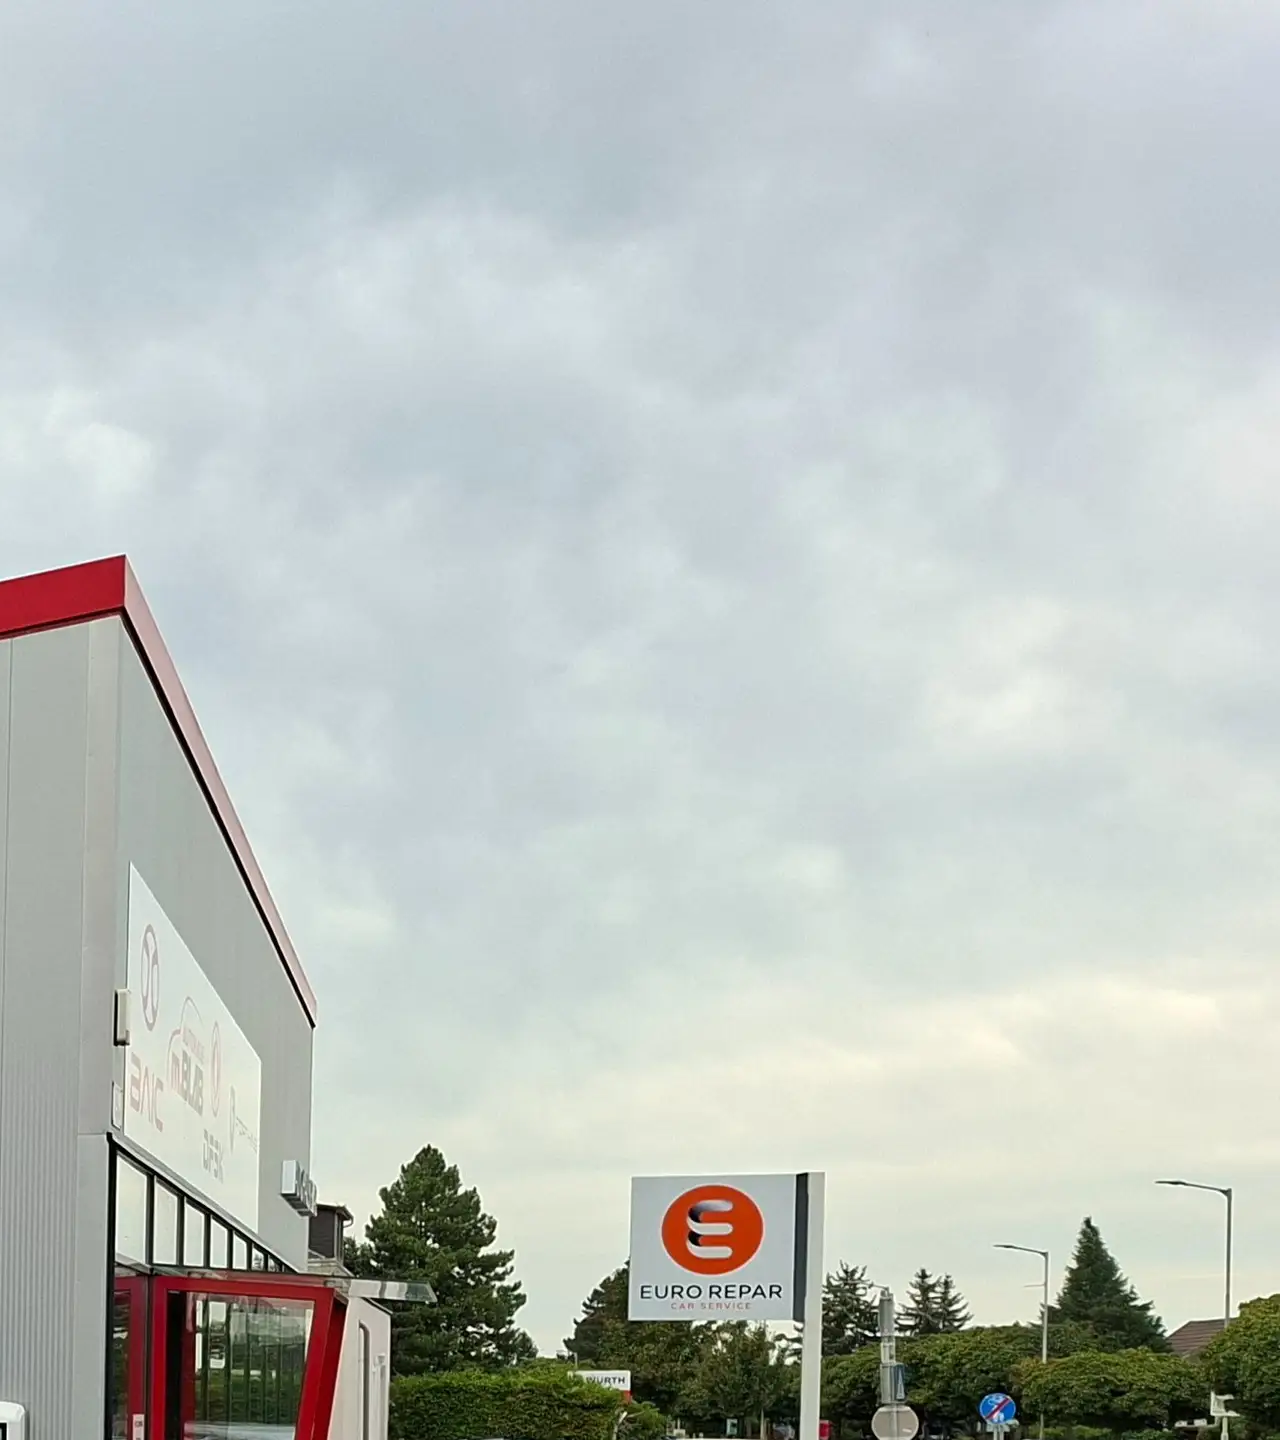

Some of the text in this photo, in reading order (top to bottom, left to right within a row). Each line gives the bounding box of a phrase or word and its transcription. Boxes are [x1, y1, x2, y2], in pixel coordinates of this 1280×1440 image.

[640, 1284, 782, 1299] EURO REPAR
[670, 1302, 752, 1310] CAR SERVICE
